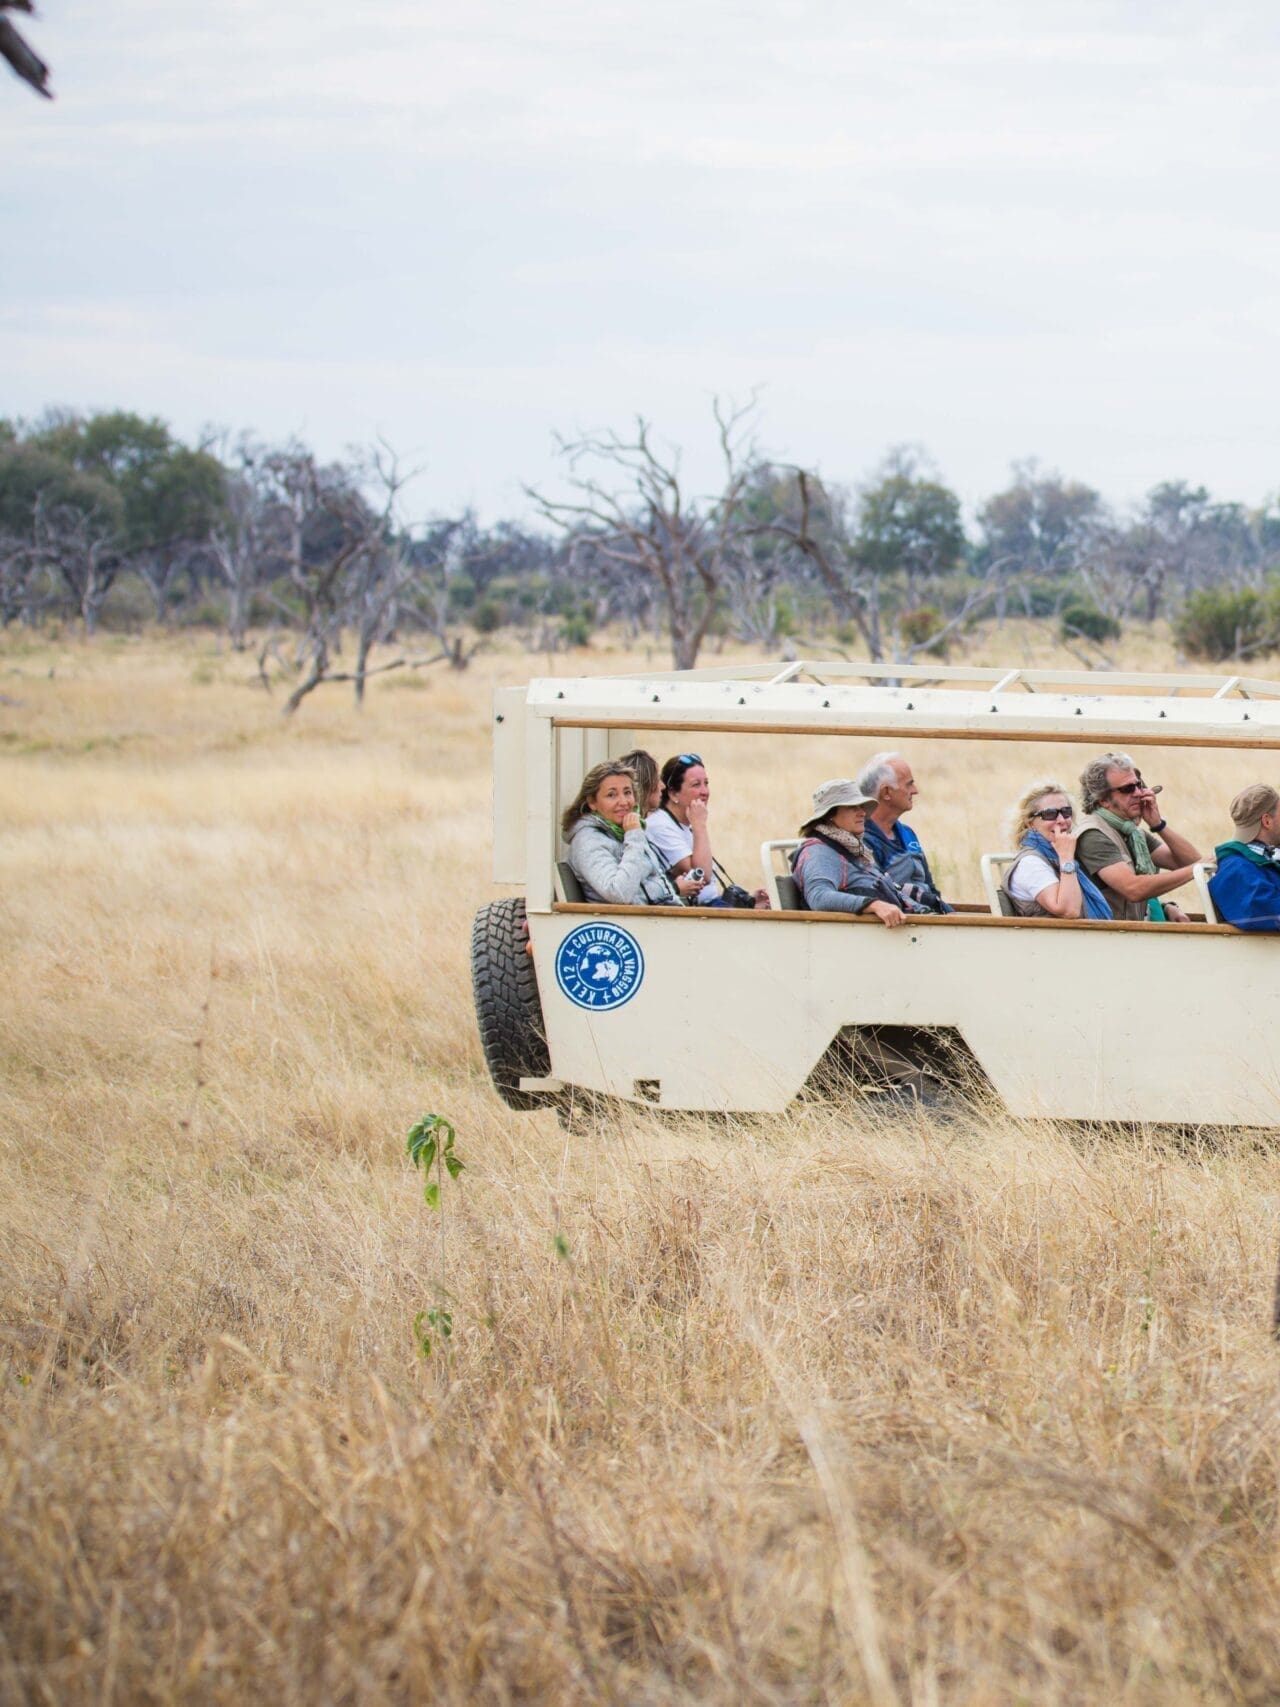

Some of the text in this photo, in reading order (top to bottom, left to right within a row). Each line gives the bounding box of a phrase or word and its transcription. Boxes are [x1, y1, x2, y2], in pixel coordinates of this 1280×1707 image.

[572, 929, 635, 997] CULTURA DEL VIAGGIO
